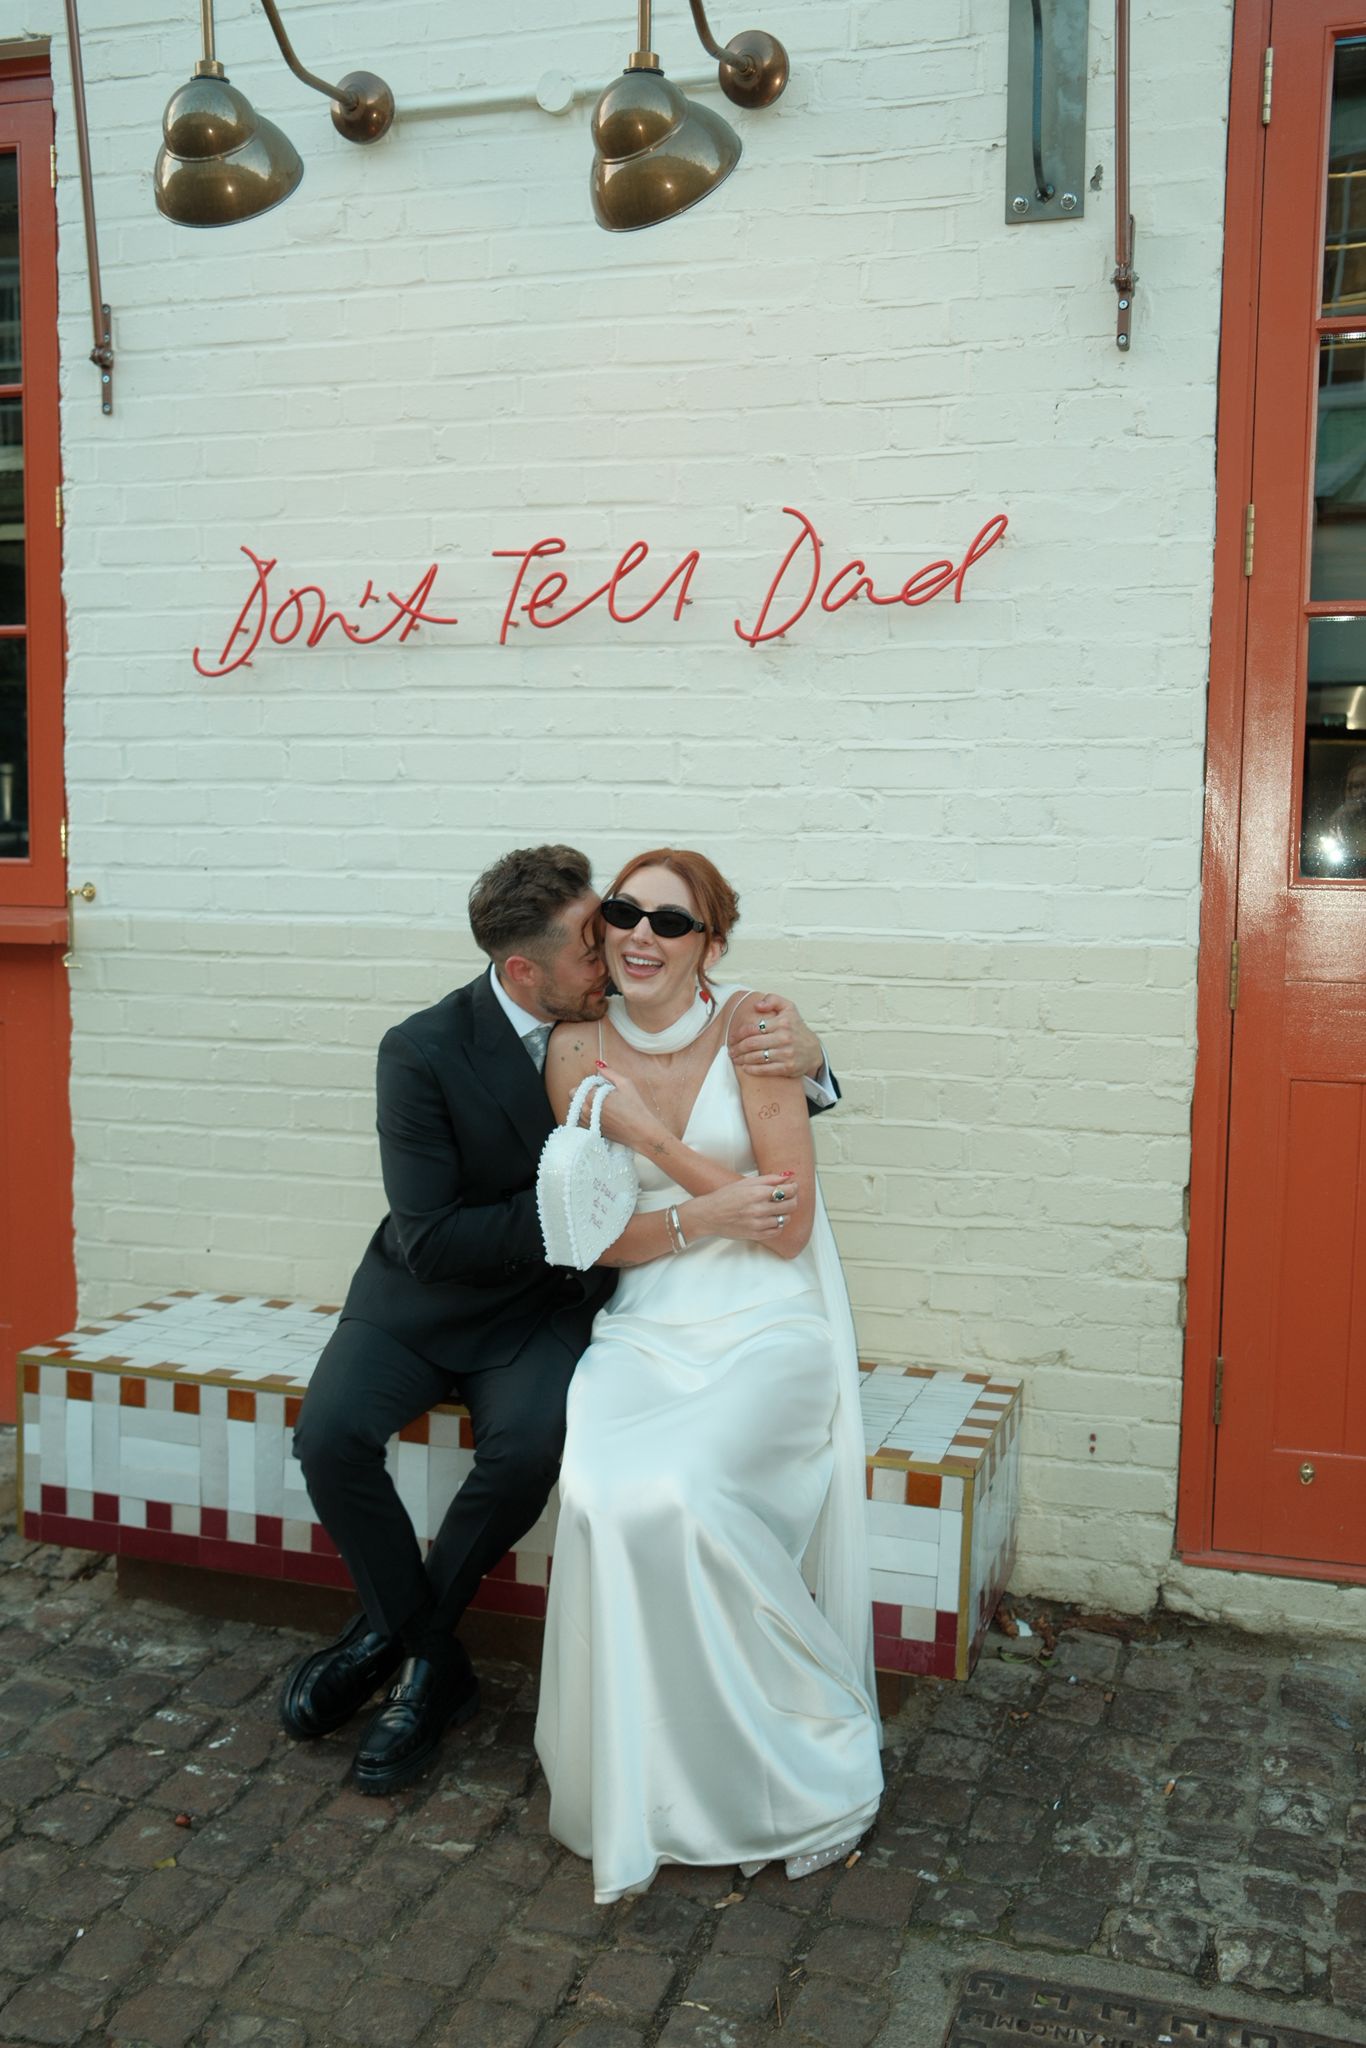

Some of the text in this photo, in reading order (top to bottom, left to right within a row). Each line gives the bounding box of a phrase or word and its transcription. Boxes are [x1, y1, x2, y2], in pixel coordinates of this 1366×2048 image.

[194, 507, 1008, 676] Don't Tell Dad
